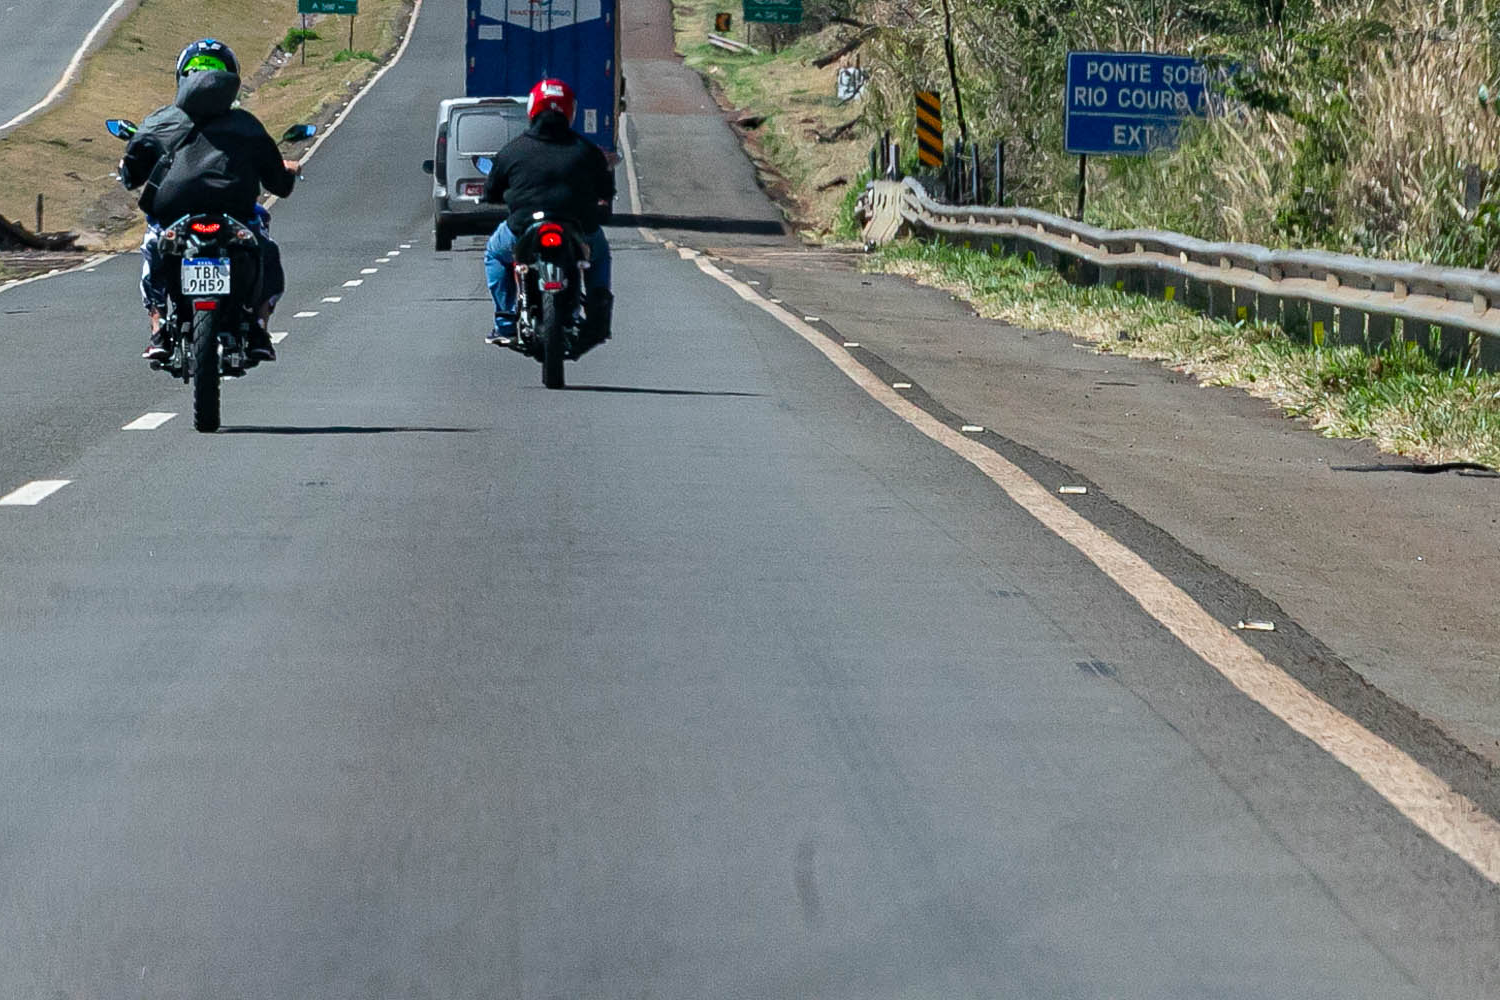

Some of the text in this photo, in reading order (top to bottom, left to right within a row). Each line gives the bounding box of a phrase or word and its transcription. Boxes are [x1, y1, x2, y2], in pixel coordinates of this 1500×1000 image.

[1086, 61, 1151, 83] PONTE
[1074, 86, 1108, 107] RIO
[1118, 88, 1188, 110] COURO
[194, 266, 220, 279] TBR
